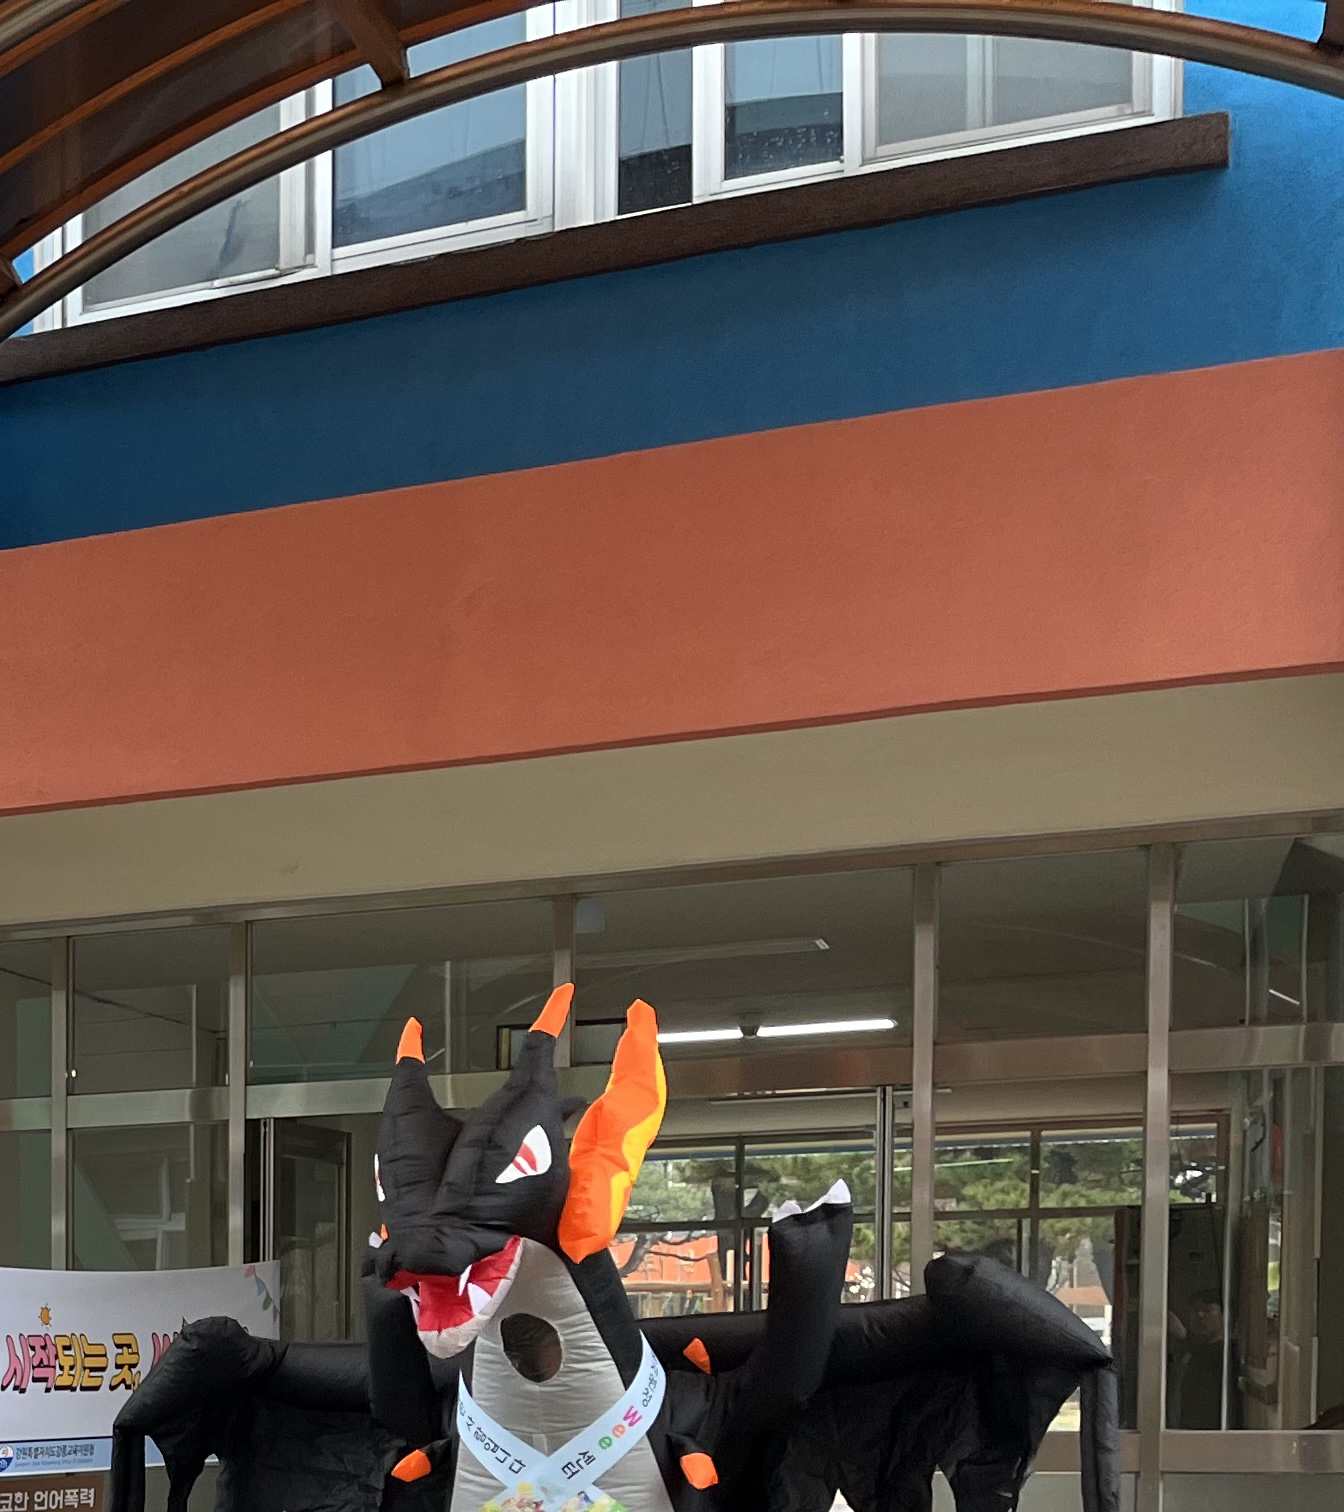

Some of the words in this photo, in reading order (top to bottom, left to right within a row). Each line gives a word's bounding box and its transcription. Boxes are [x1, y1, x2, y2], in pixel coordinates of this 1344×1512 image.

[0, 1332, 109, 1393] 시작되는
[598, 1404, 643, 1450] Wee
[561, 1450, 597, 1480] 센터
[34, 1487, 95, 1511] 언어폭력
